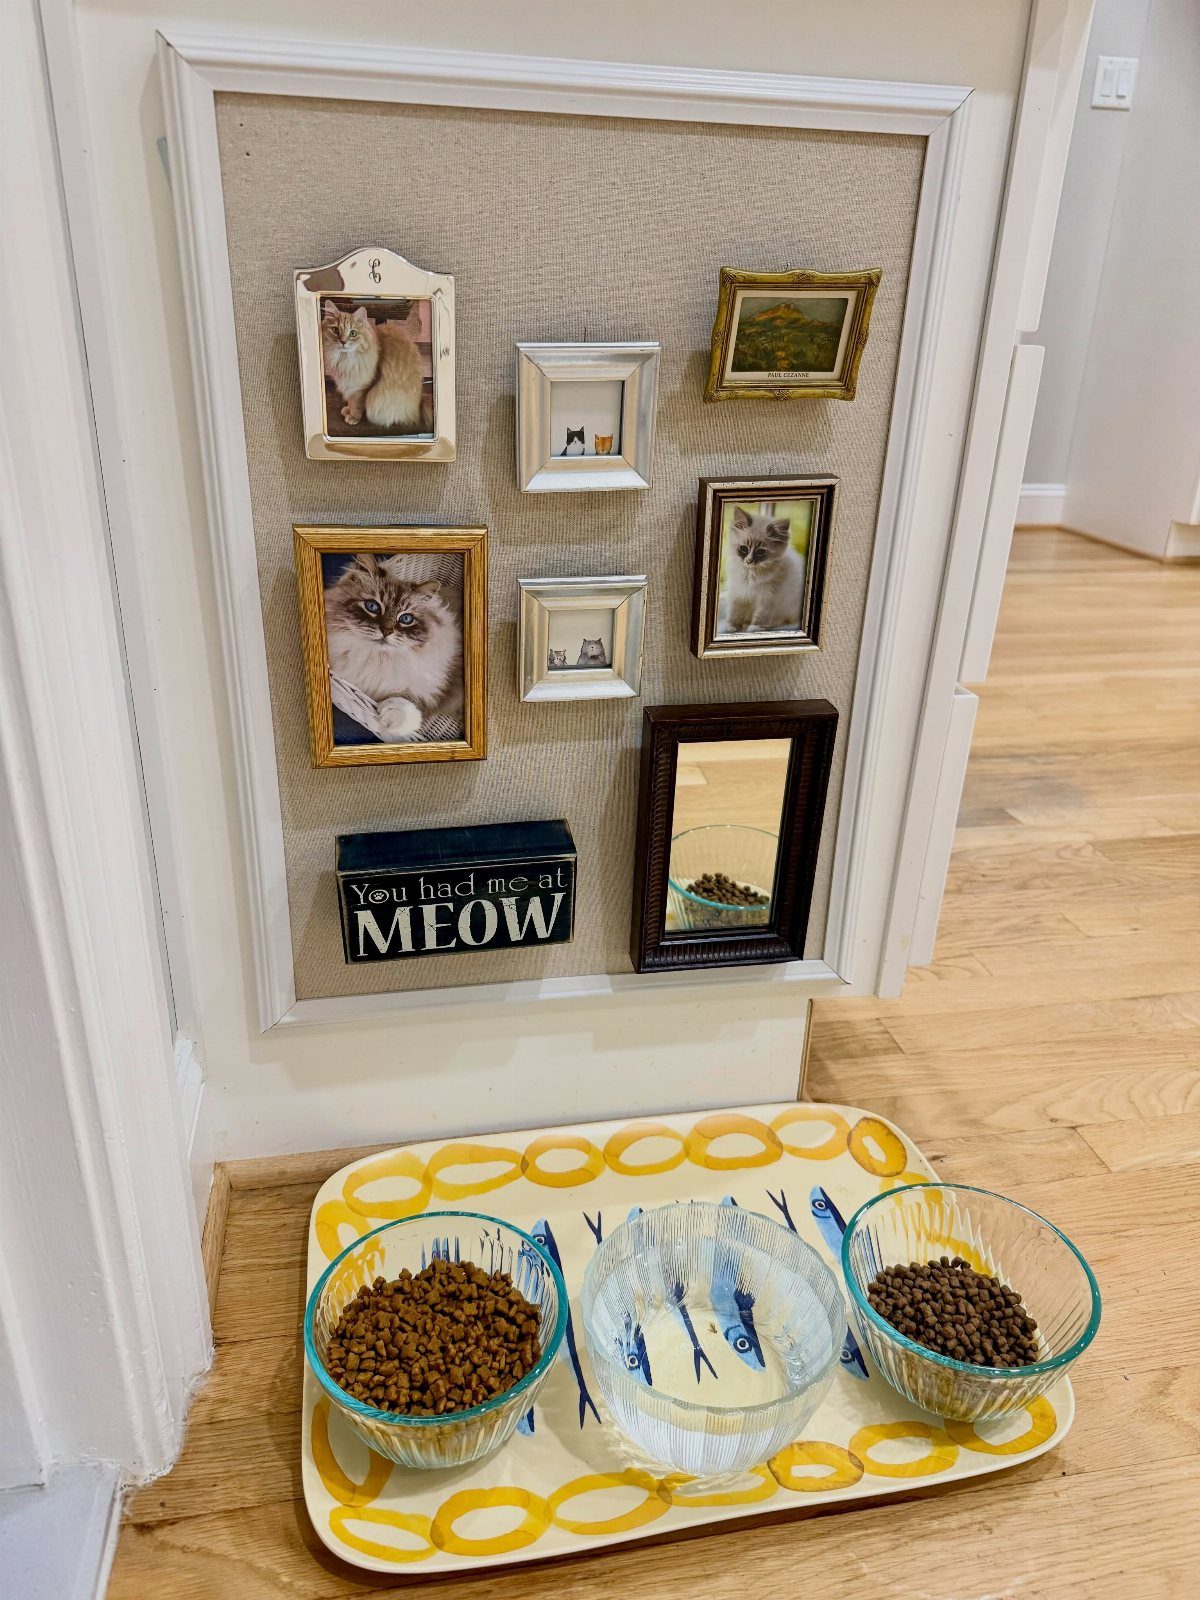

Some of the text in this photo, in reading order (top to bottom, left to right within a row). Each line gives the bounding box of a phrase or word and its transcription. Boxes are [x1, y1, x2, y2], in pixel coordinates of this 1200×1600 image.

[350, 867, 568, 905] You had me at
[353, 892, 567, 957] MEOW
